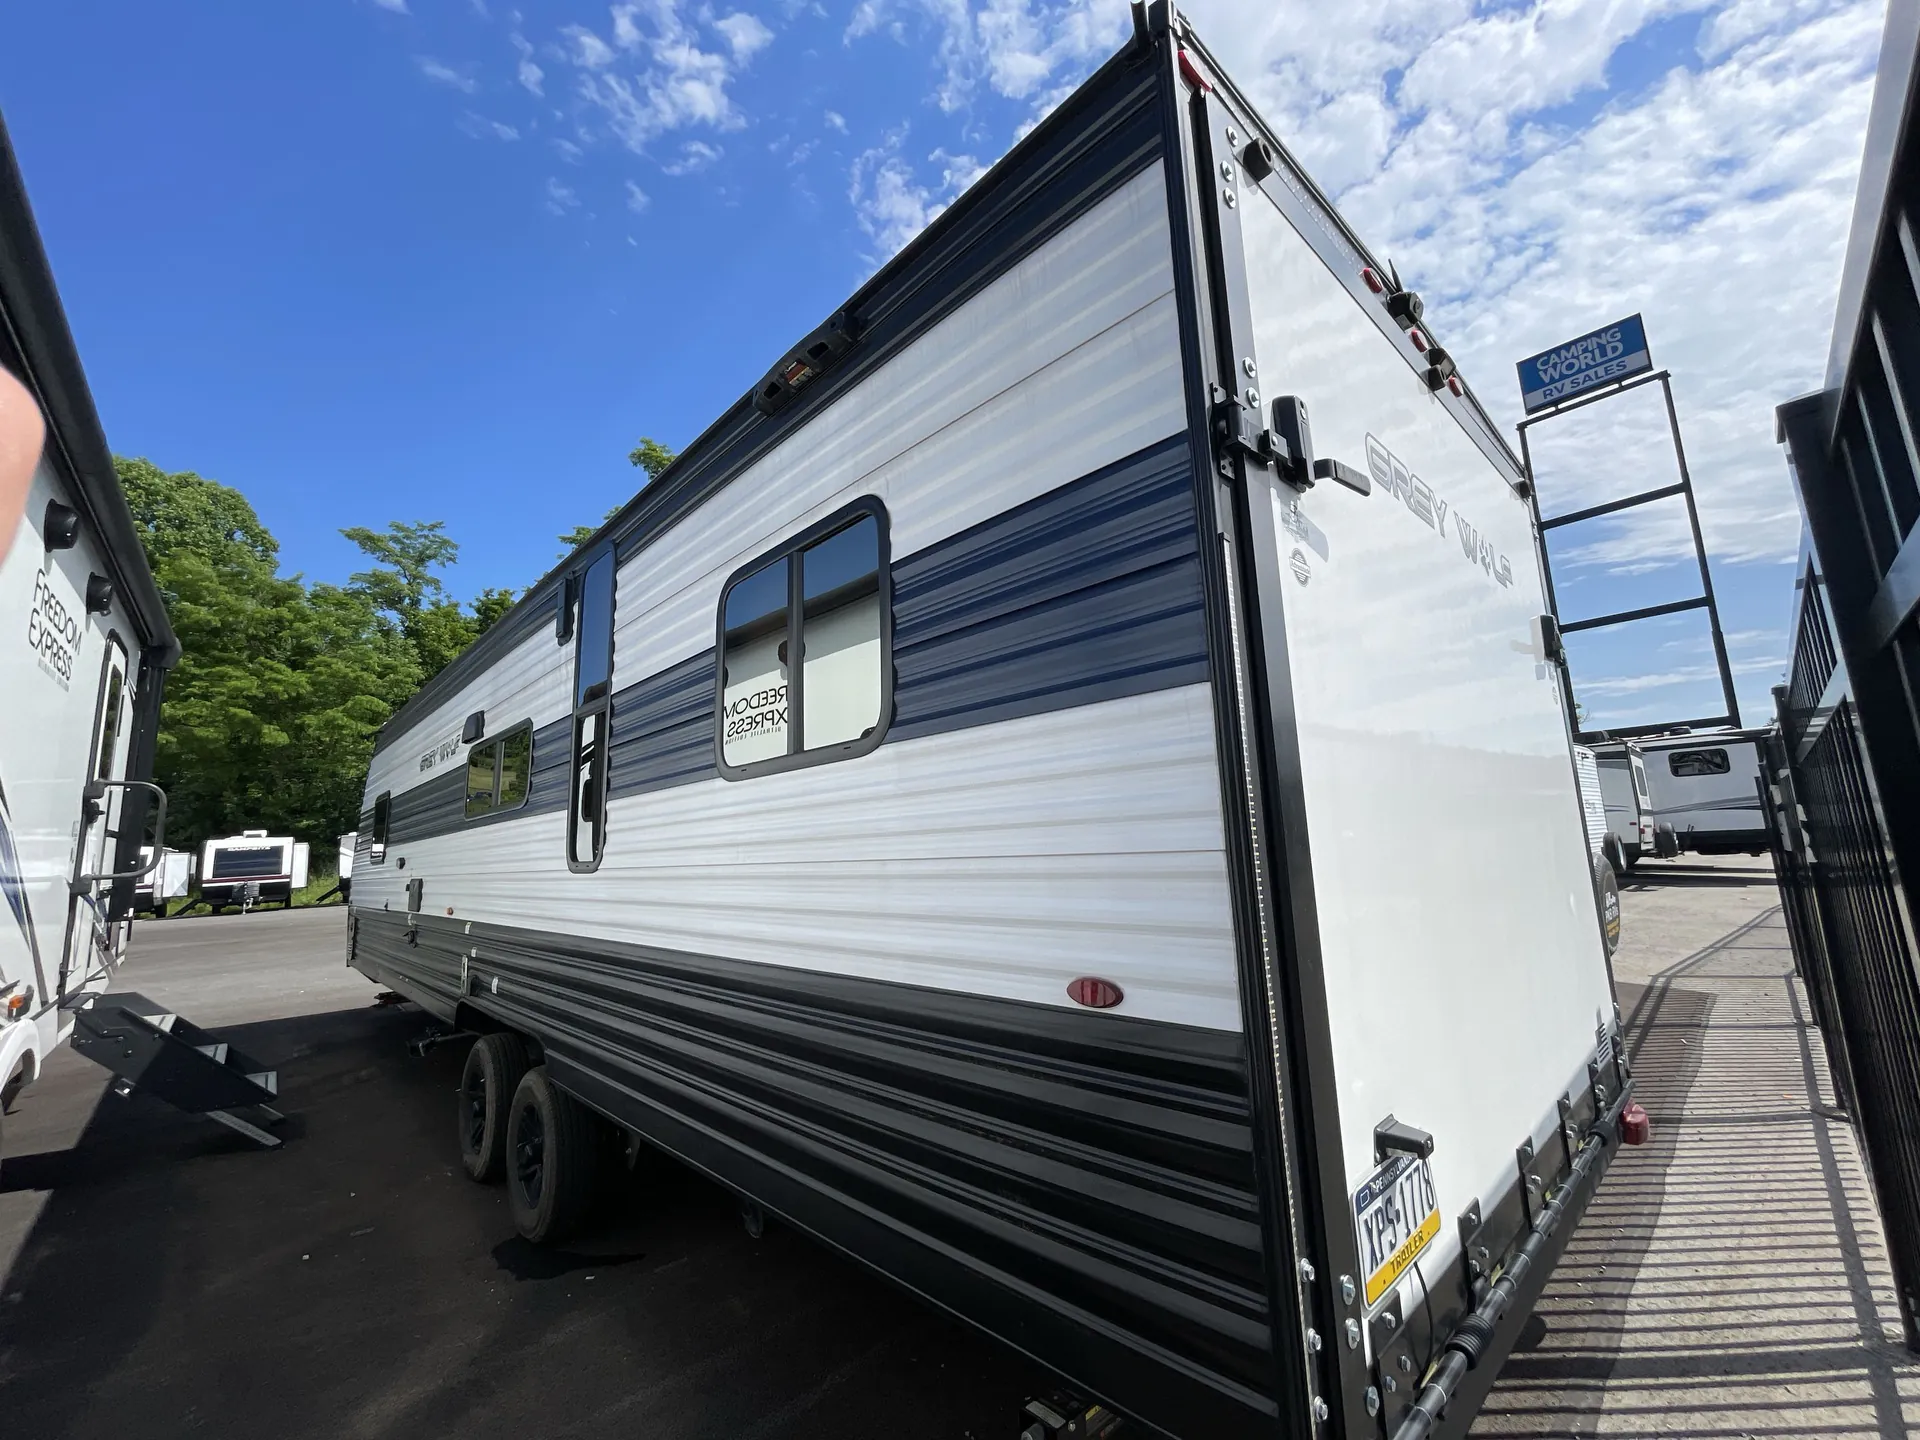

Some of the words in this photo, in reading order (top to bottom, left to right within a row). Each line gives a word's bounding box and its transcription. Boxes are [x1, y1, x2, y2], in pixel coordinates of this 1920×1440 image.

[1536, 327, 1622, 370] CAMPING
[1538, 341, 1624, 384] WORLD
[1542, 382, 1566, 400] RV
[1570, 360, 1628, 389] SALES
[1365, 431, 1448, 539] GREY
[33, 568, 83, 656] FREEDOM
[28, 607, 73, 681] EXPRESS
[1389, 1230, 1425, 1275] TRAILER
